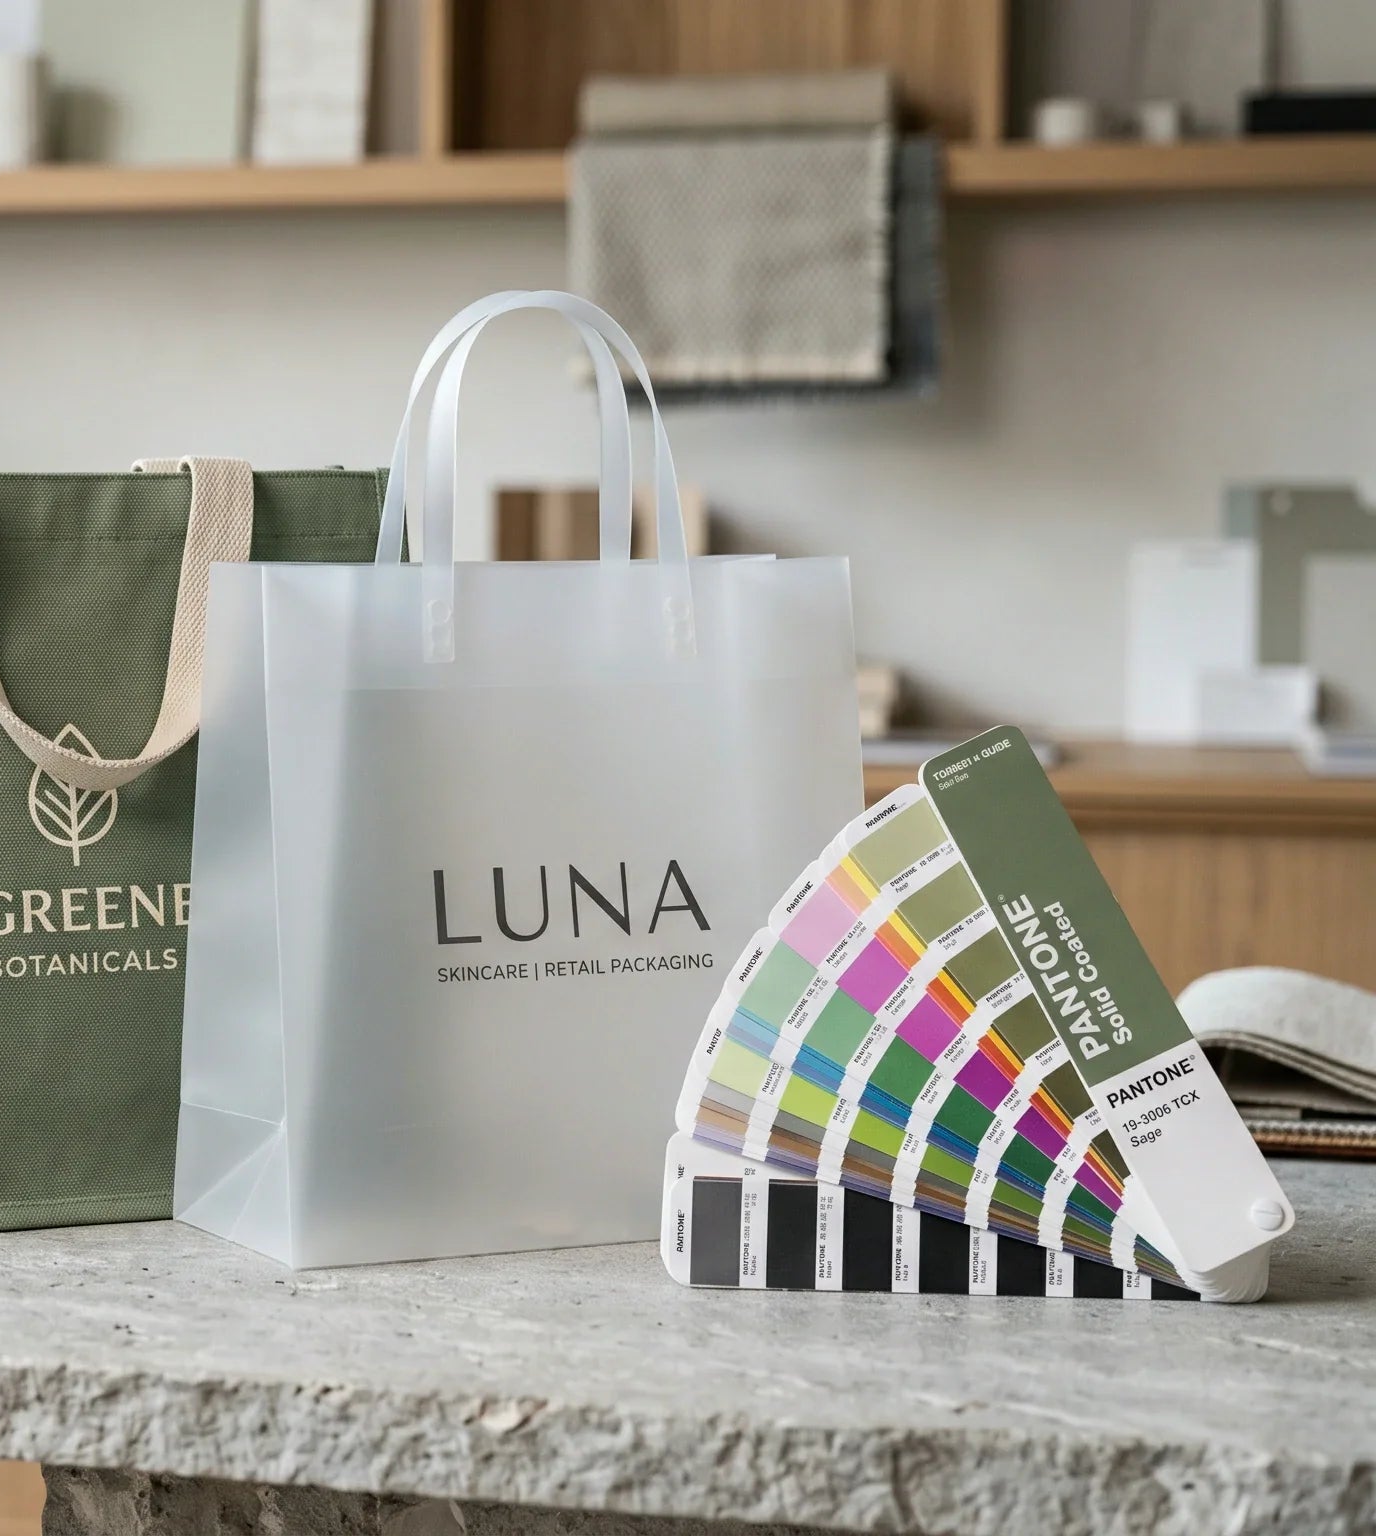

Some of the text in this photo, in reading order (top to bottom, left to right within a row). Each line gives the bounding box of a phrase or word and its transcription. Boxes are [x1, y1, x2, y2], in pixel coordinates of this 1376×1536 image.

[433, 859, 711, 944] LUNA
[438, 963, 528, 983] SKINCARE
[545, 959, 605, 977] RETAIL
[611, 953, 714, 973] PACKAGING
[1043, 901, 1098, 983] Coated
[1001, 894, 1110, 1061] PANTONE
[1089, 986, 1133, 1045] Solid
[1106, 1057, 1195, 1109] PANTONE
[1122, 1103, 1172, 1133] 19-3006
[1171, 1089, 1201, 1110] TCX
[1130, 1126, 1163, 1148] Sage
